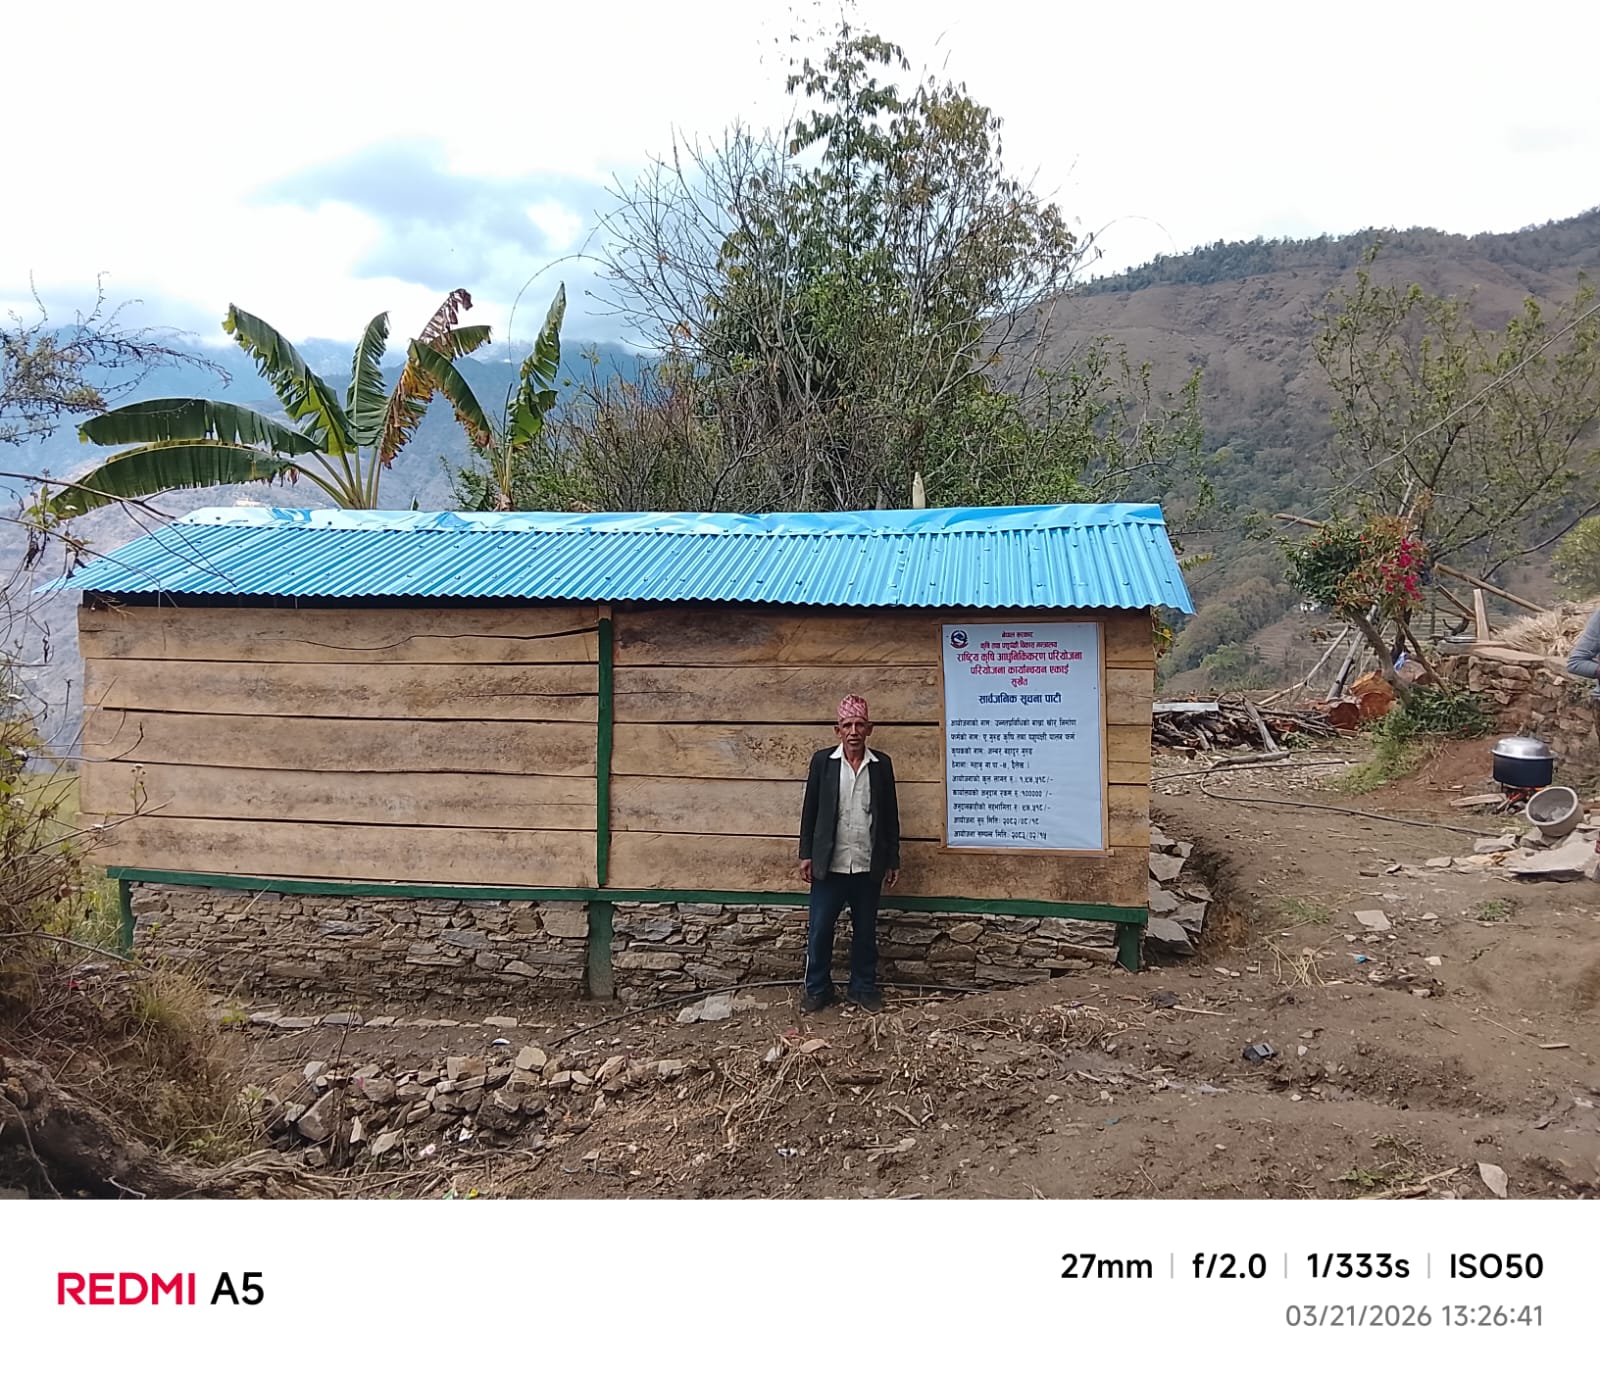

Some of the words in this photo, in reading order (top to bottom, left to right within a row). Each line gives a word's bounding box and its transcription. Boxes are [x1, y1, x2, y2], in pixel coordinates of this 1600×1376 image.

[981, 650, 995, 663] कृषि
[1048, 650, 1083, 661] परियोजना
[970, 663, 1006, 675] परियोजना
[978, 692, 1017, 704] सार्वजनिक
[1020, 694, 1043, 705] सूचना
[1045, 693, 1062, 703] पाटी
